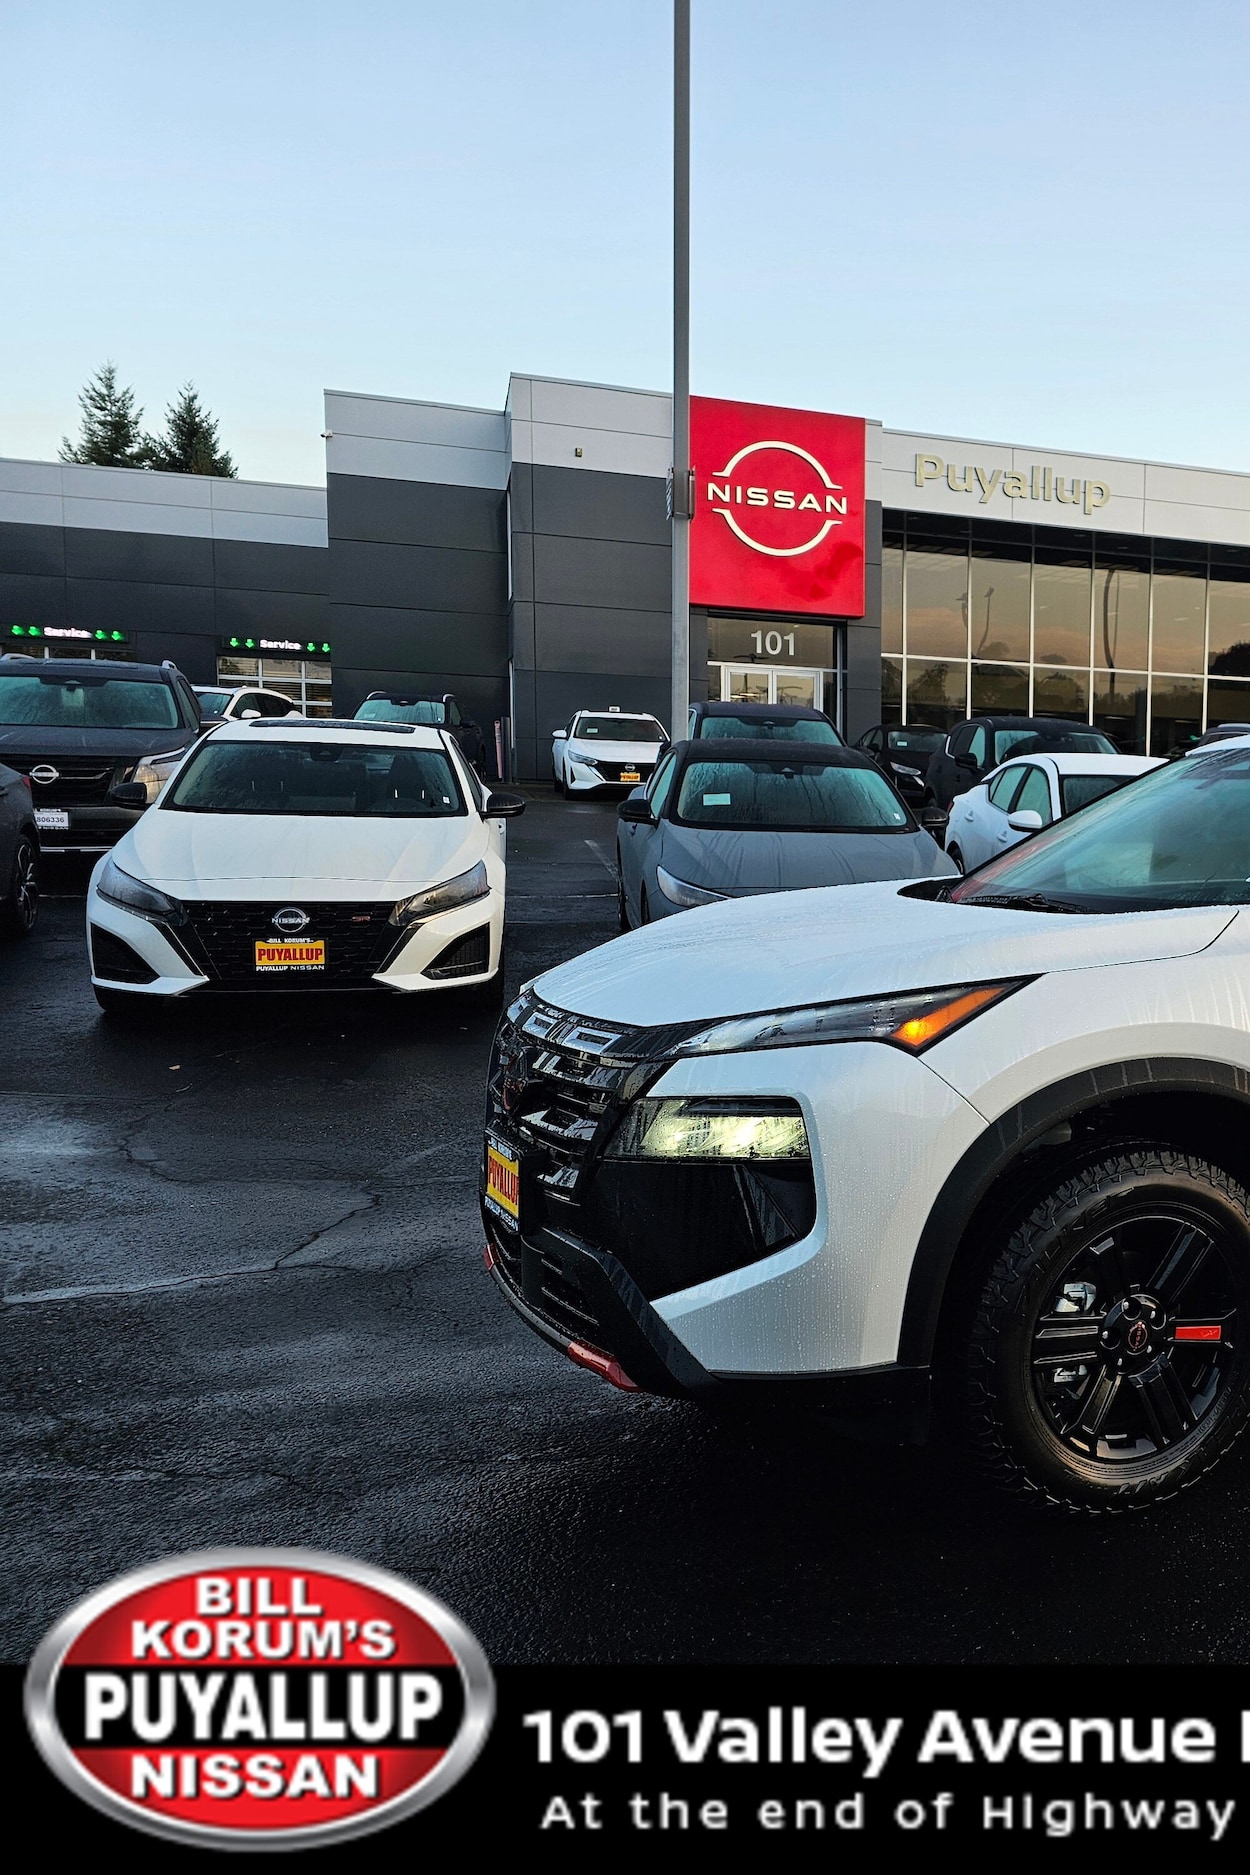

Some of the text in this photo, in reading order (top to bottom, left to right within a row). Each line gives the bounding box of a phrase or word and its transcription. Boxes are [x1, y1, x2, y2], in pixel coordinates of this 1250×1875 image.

[914, 452, 1112, 516] Puyallup
[707, 481, 848, 516] NISSAN
[43, 626, 93, 640] Service
[259, 638, 303, 651] Service
[750, 629, 796, 656] 101
[271, 917, 310, 925] NISSAN
[257, 948, 324, 961] PUYALLUP
[255, 963, 325, 972] PUYALLUP NISSAN
